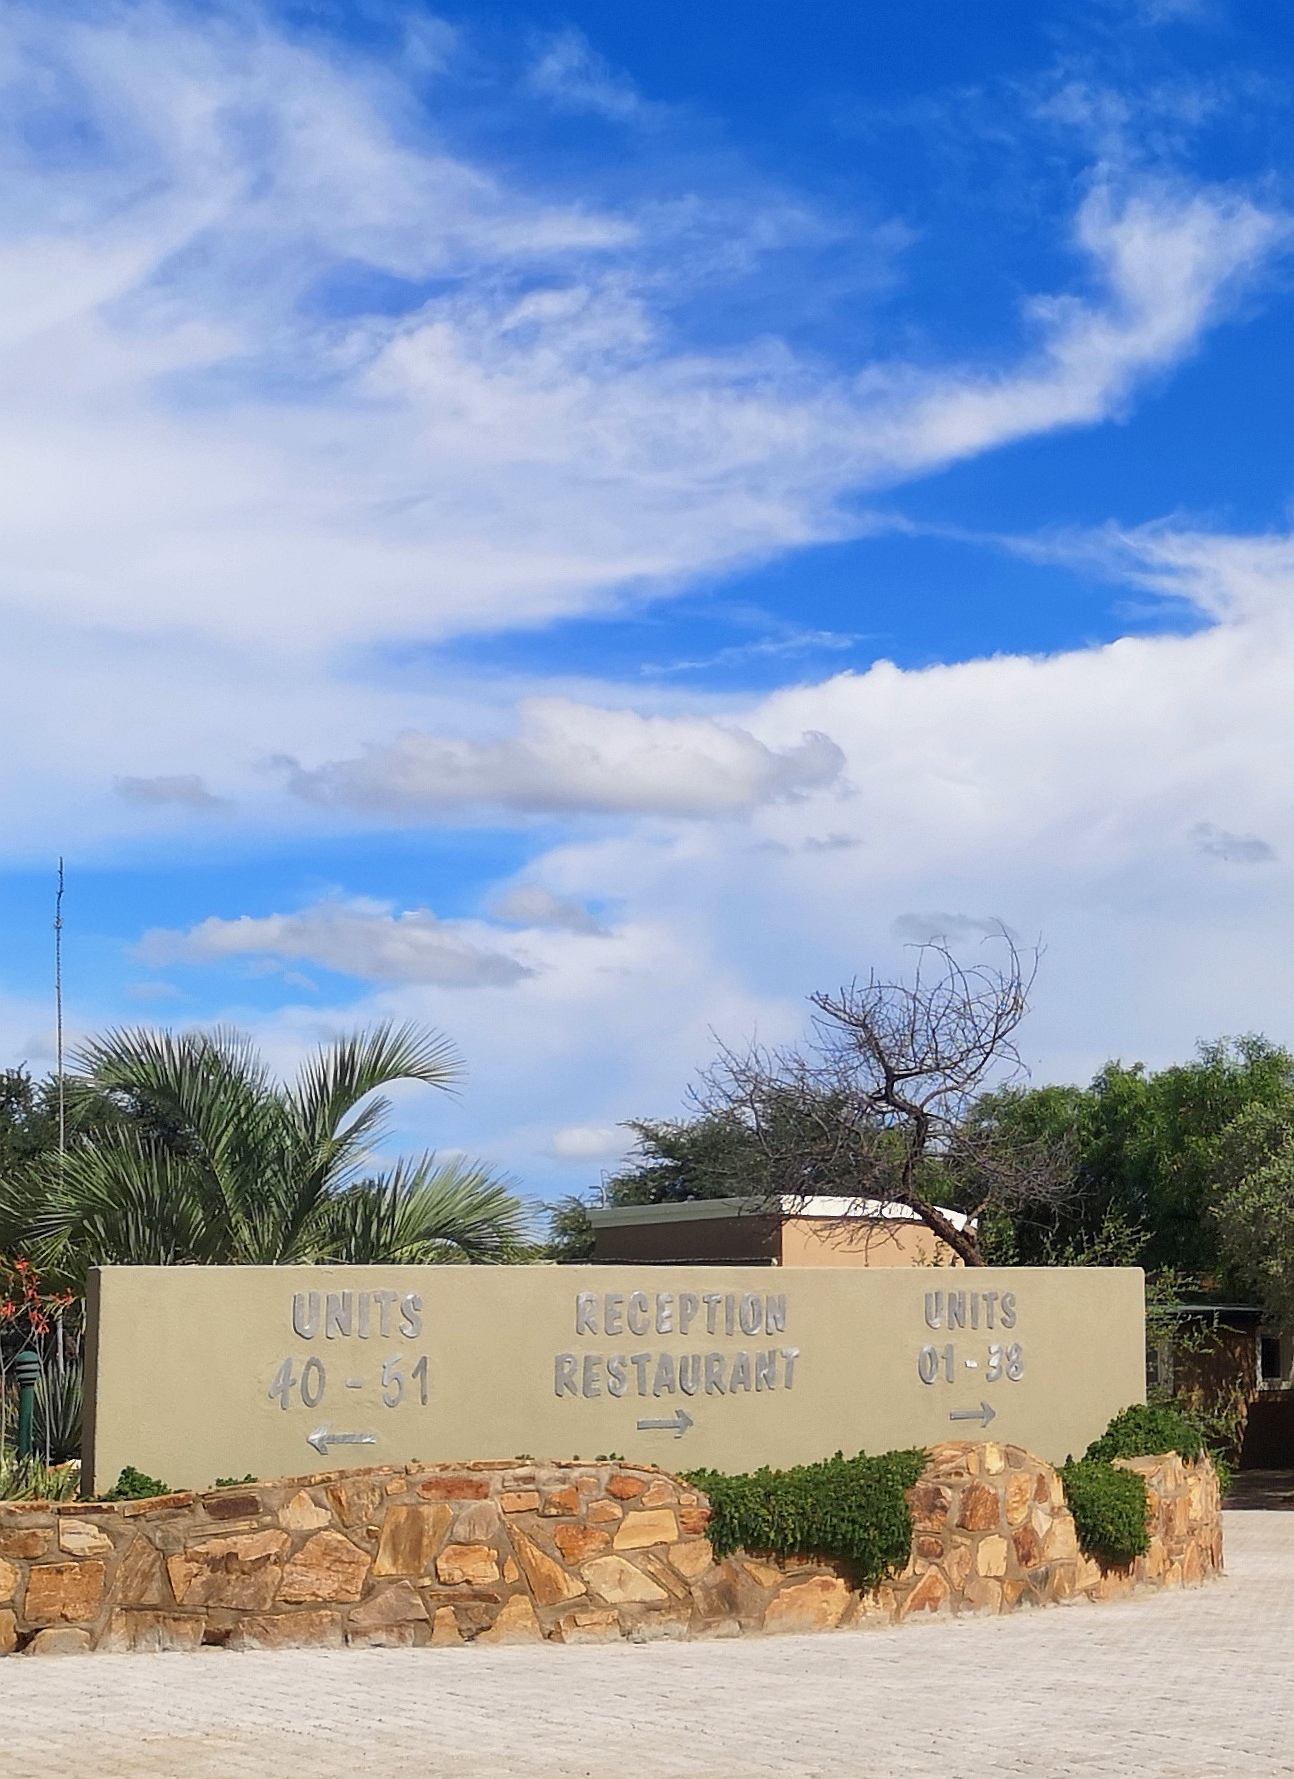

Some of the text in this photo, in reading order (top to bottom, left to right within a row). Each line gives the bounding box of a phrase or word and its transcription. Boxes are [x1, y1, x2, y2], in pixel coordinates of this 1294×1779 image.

[293, 1290, 423, 1340] UNITS
[575, 1290, 787, 1336] RECEPTION
[924, 1290, 1017, 1330] UNITS
[268, 1356, 326, 1410] 40
[381, 1355, 428, 1408] 51
[554, 1347, 800, 1398] RESTAURANT
